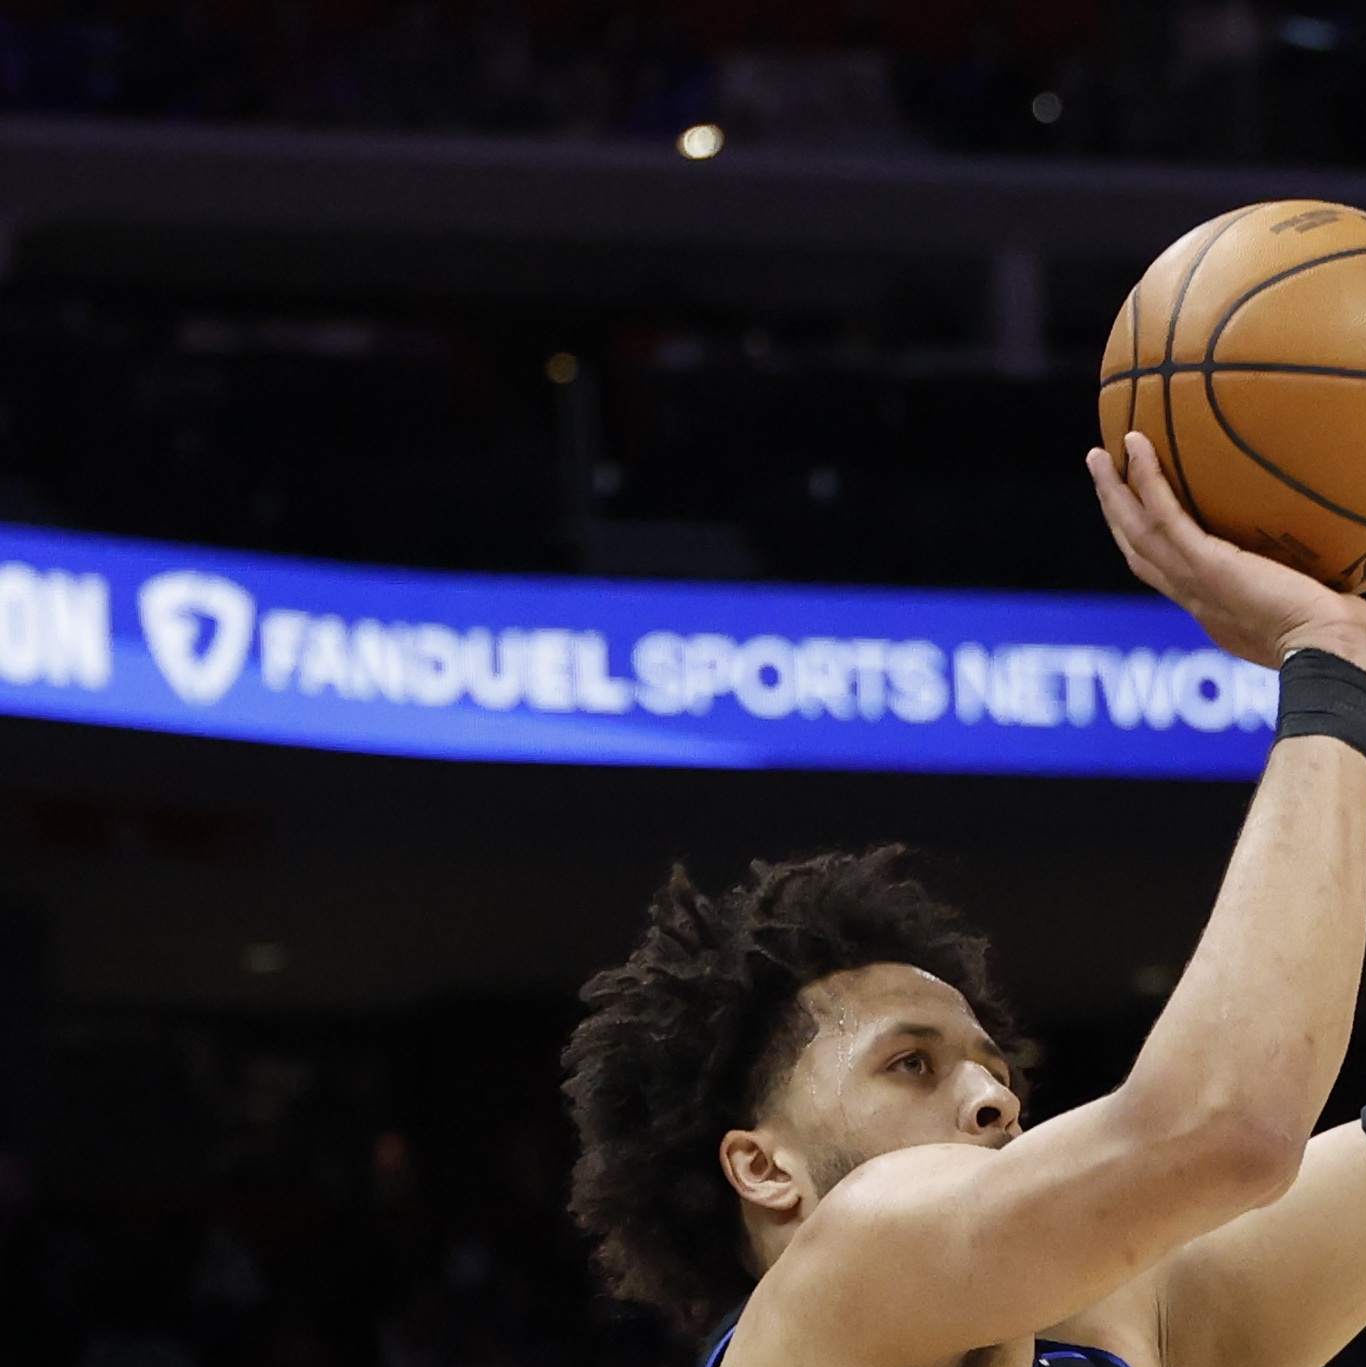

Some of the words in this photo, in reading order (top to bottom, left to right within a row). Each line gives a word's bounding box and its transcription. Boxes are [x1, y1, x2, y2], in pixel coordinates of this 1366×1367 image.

[261, 608, 634, 716] FANDUEL
[632, 629, 952, 724] SPORTS
[953, 640, 1282, 732] NETWOR
